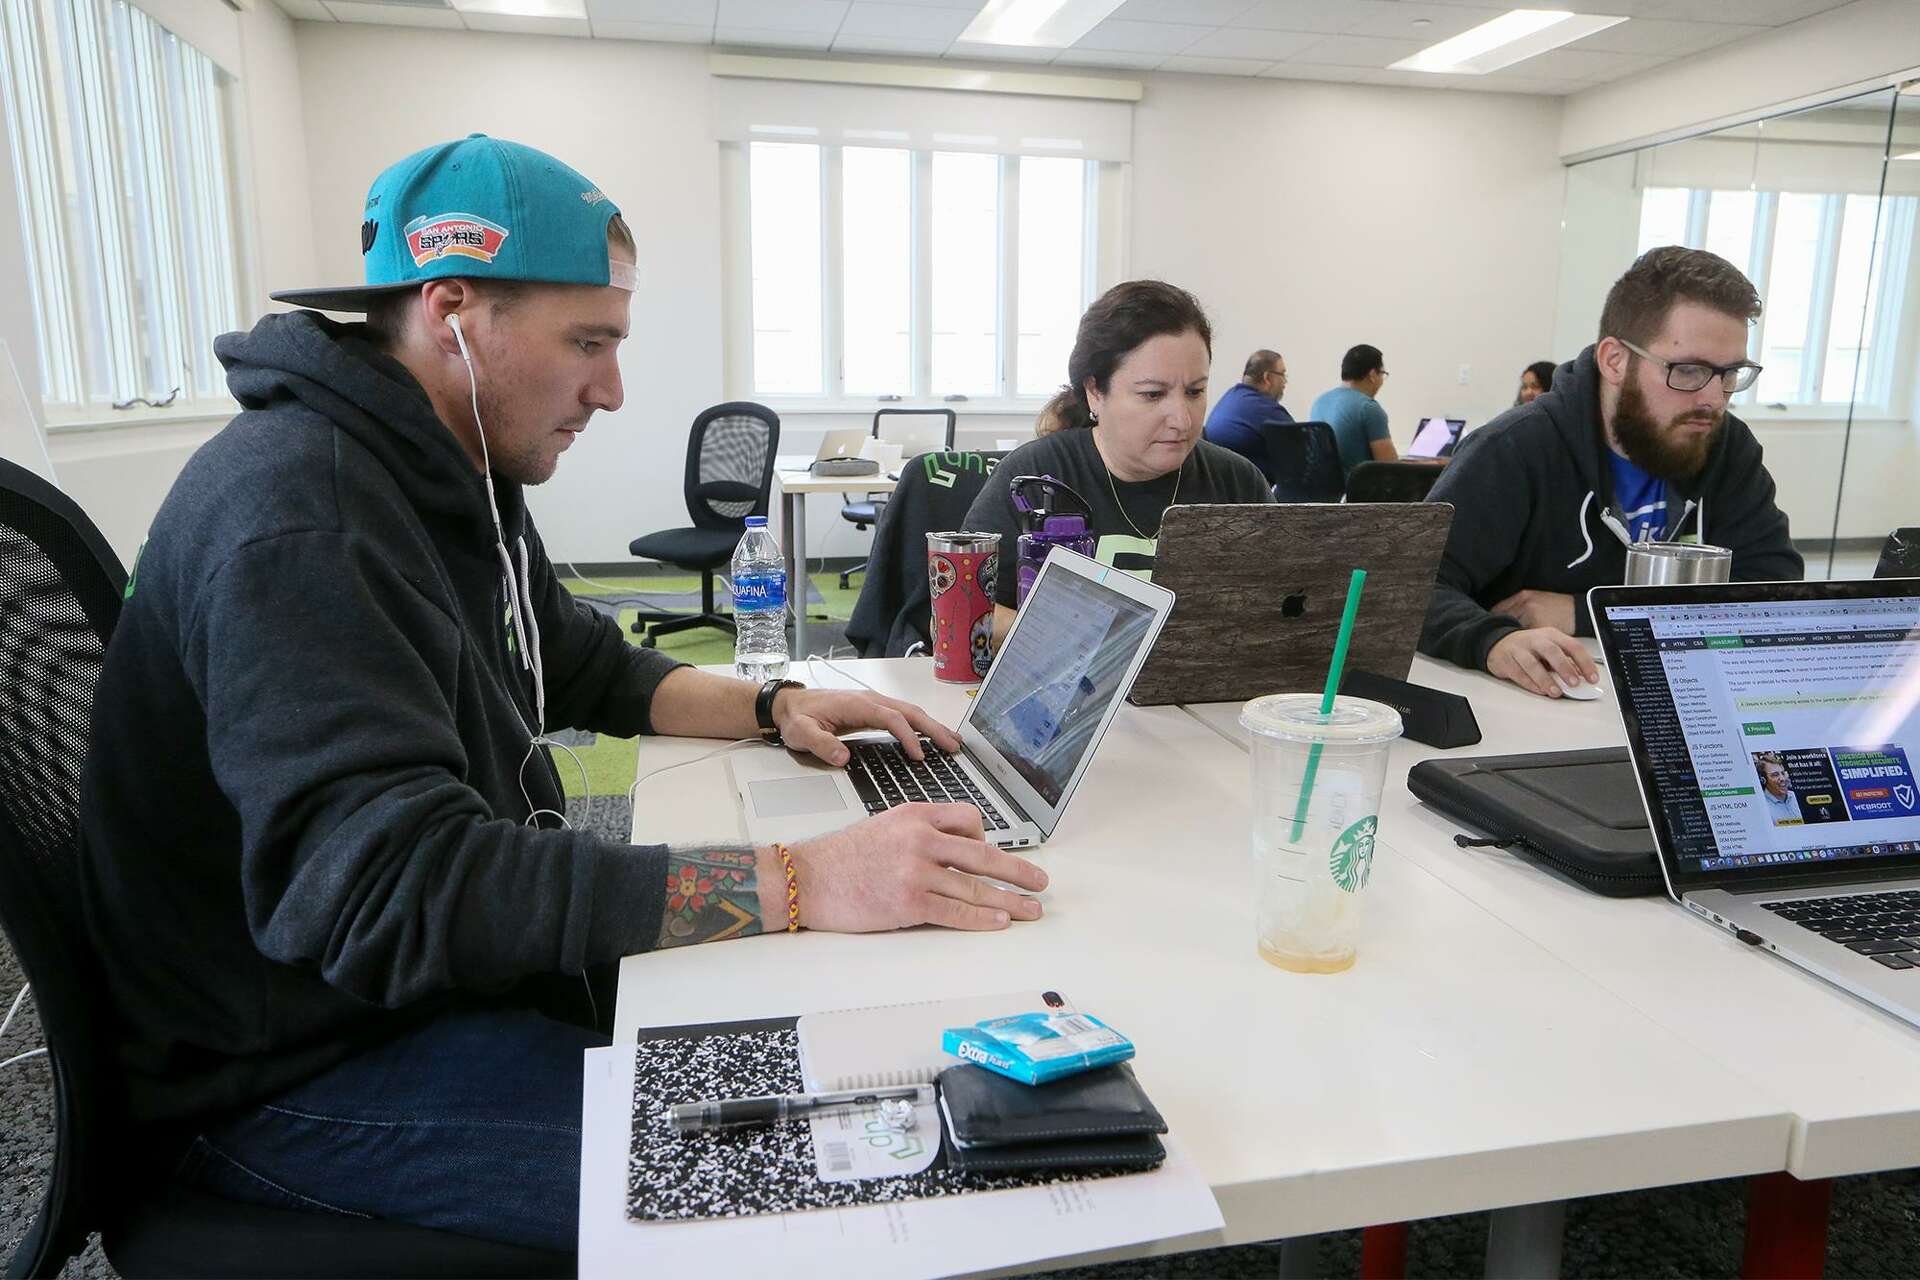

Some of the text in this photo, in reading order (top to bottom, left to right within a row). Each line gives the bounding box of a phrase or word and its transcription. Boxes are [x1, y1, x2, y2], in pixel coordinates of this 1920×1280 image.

[440, 224, 484, 233] ANTONIO
[420, 230, 484, 250] SPURS
[1841, 765, 1907, 780] SIMPLIFIED.
[1854, 802, 1892, 810] WEBROOT
